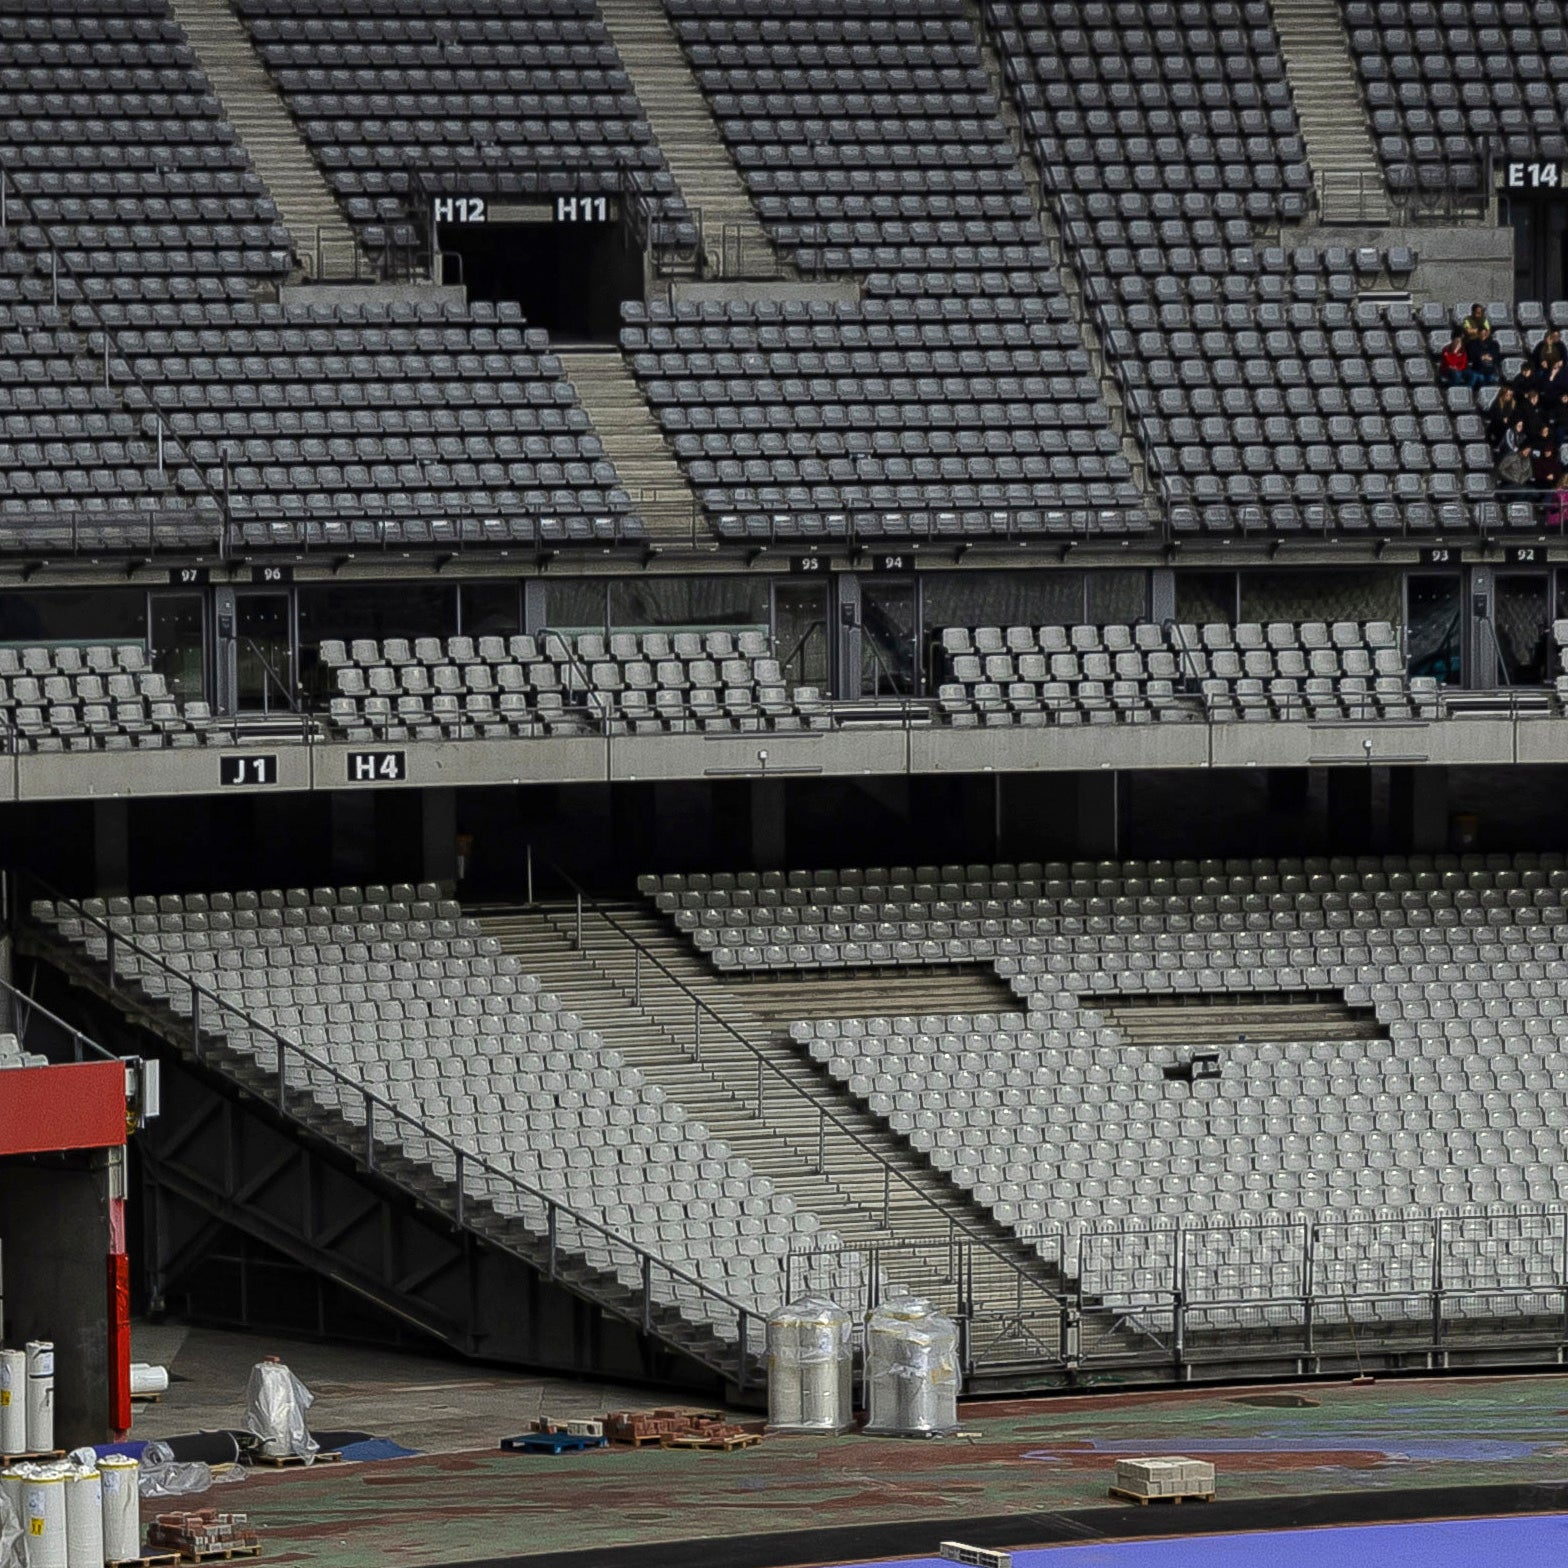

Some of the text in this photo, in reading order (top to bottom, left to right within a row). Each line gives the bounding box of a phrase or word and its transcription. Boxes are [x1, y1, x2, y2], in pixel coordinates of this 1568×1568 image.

[1509, 162, 1559, 188] E14
[434, 197, 486, 222] H12
[557, 196, 606, 222] H11
[1432, 549, 1449, 562] 93
[1517, 548, 1535, 561] 92
[801, 557, 819, 571] 95
[885, 556, 903, 569] 94
[181, 569, 198, 582] 97
[264, 567, 282, 581] 96
[232, 756, 266, 783] J1
[355, 753, 399, 779] H4
